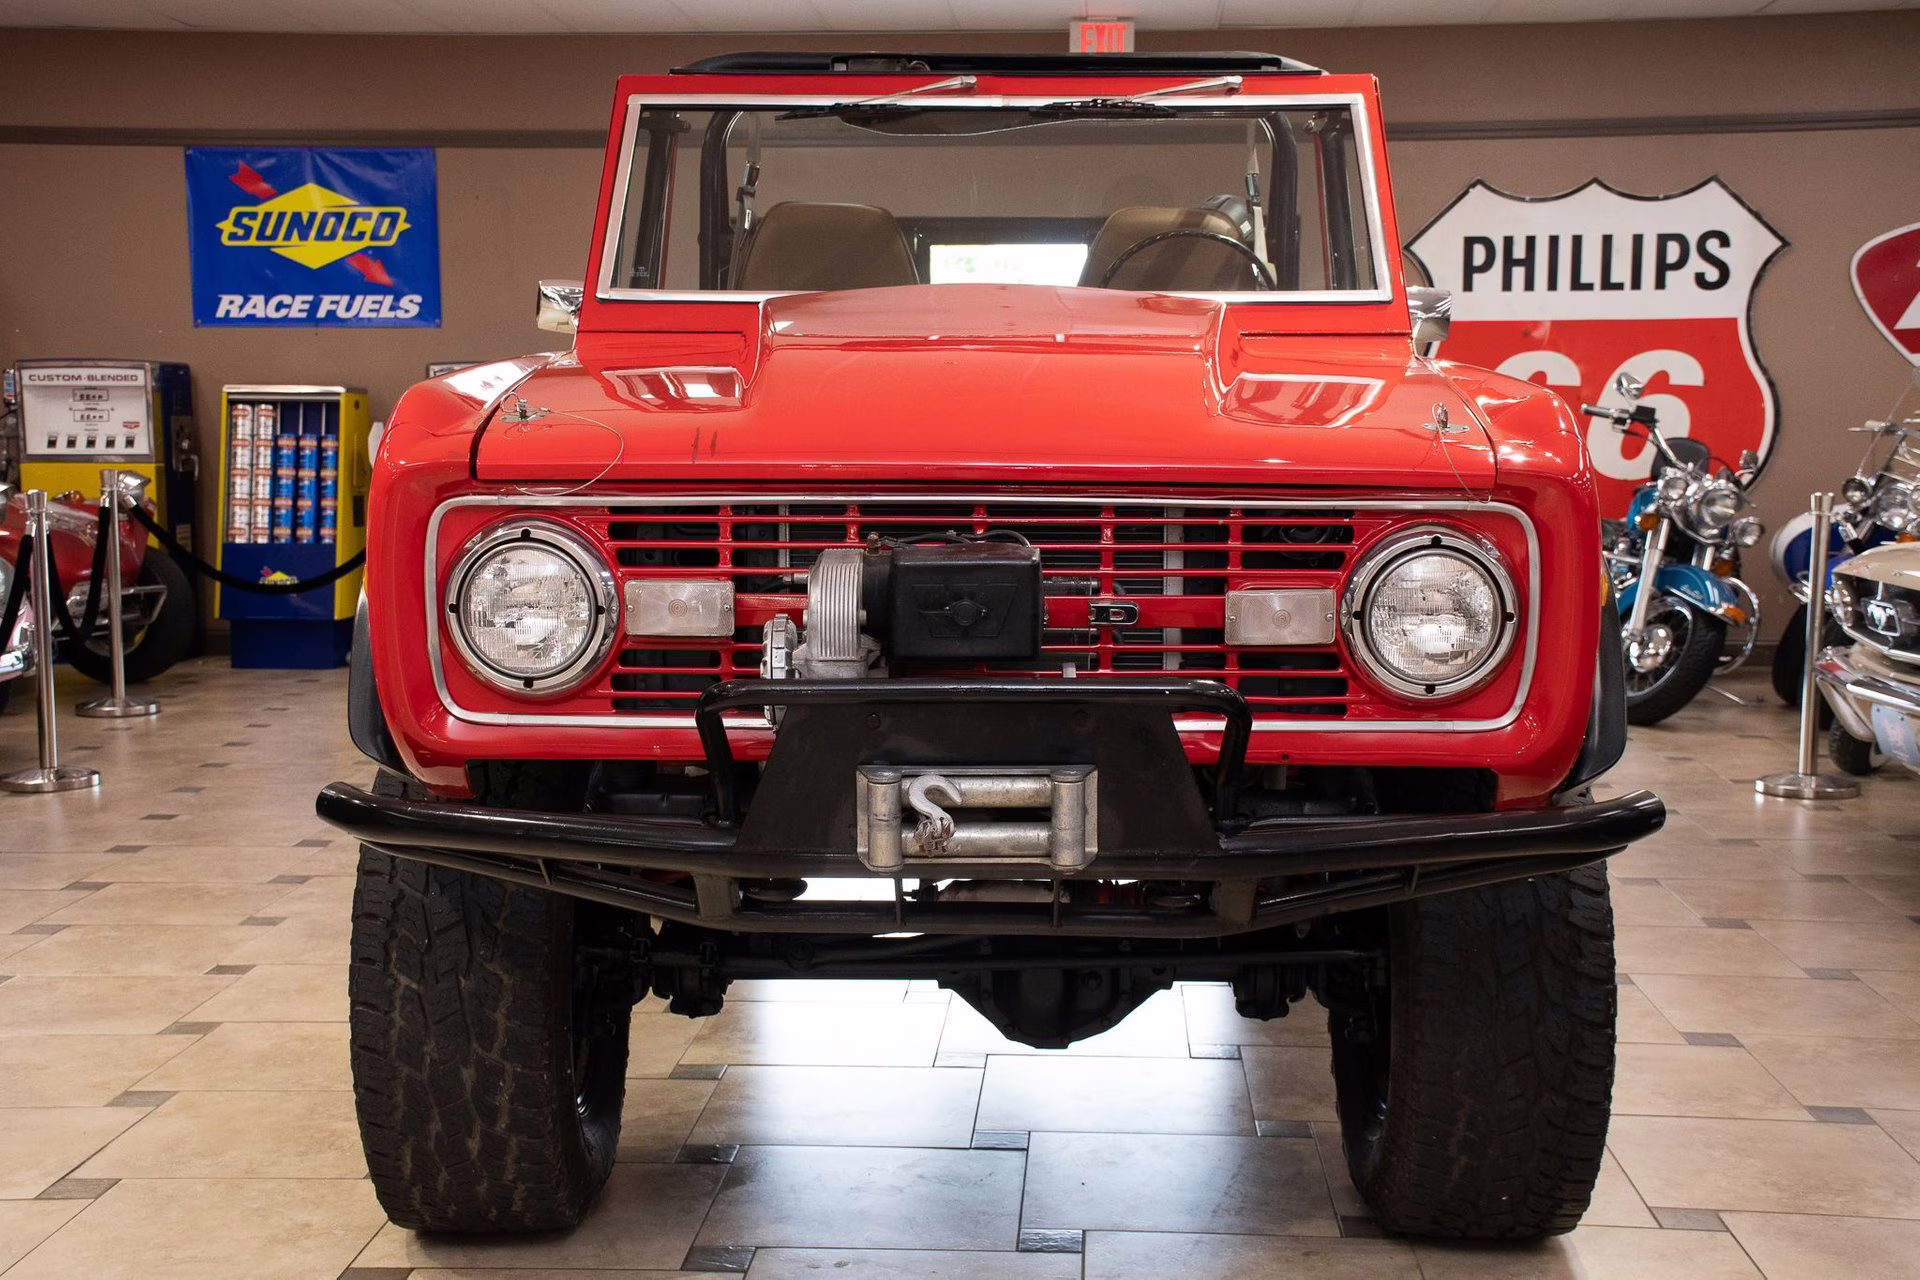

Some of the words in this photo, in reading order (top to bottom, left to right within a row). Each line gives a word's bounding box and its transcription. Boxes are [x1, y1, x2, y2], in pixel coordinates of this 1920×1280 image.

[1080, 22, 1128, 53] EXIT
[227, 211, 402, 242] SUNOCO
[1462, 230, 1731, 292] PHILLIPS
[215, 294, 314, 319] RACE
[316, 294, 423, 319] FUELS
